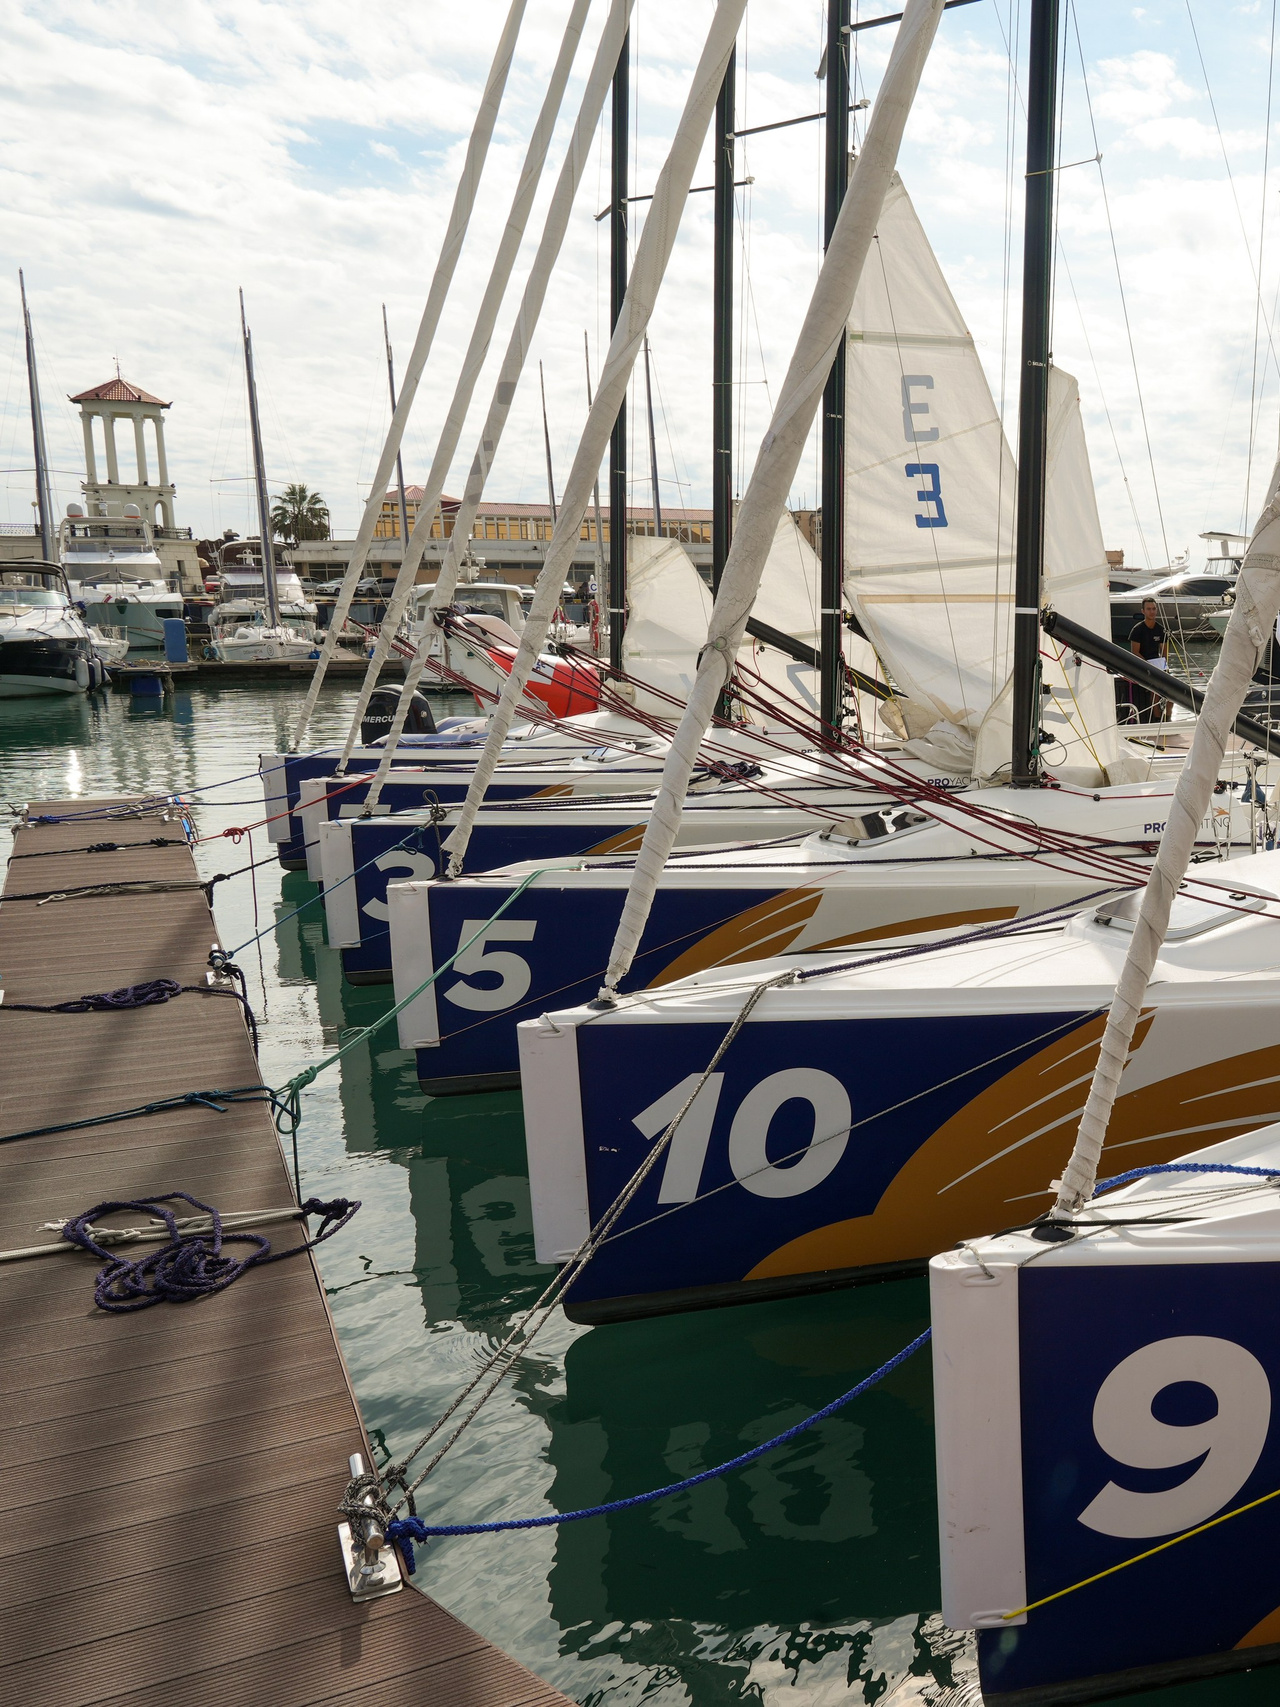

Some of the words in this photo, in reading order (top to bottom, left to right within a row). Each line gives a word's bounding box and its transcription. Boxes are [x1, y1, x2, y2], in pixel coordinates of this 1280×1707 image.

[905, 463, 948, 528] 3
[590, 583, 598, 592] C
[362, 715, 396, 724] MERCU
[361, 850, 436, 922] 3
[442, 919, 537, 1012] 5
[632, 1066, 852, 1206] 10
[1078, 1335, 1271, 1539] 9
